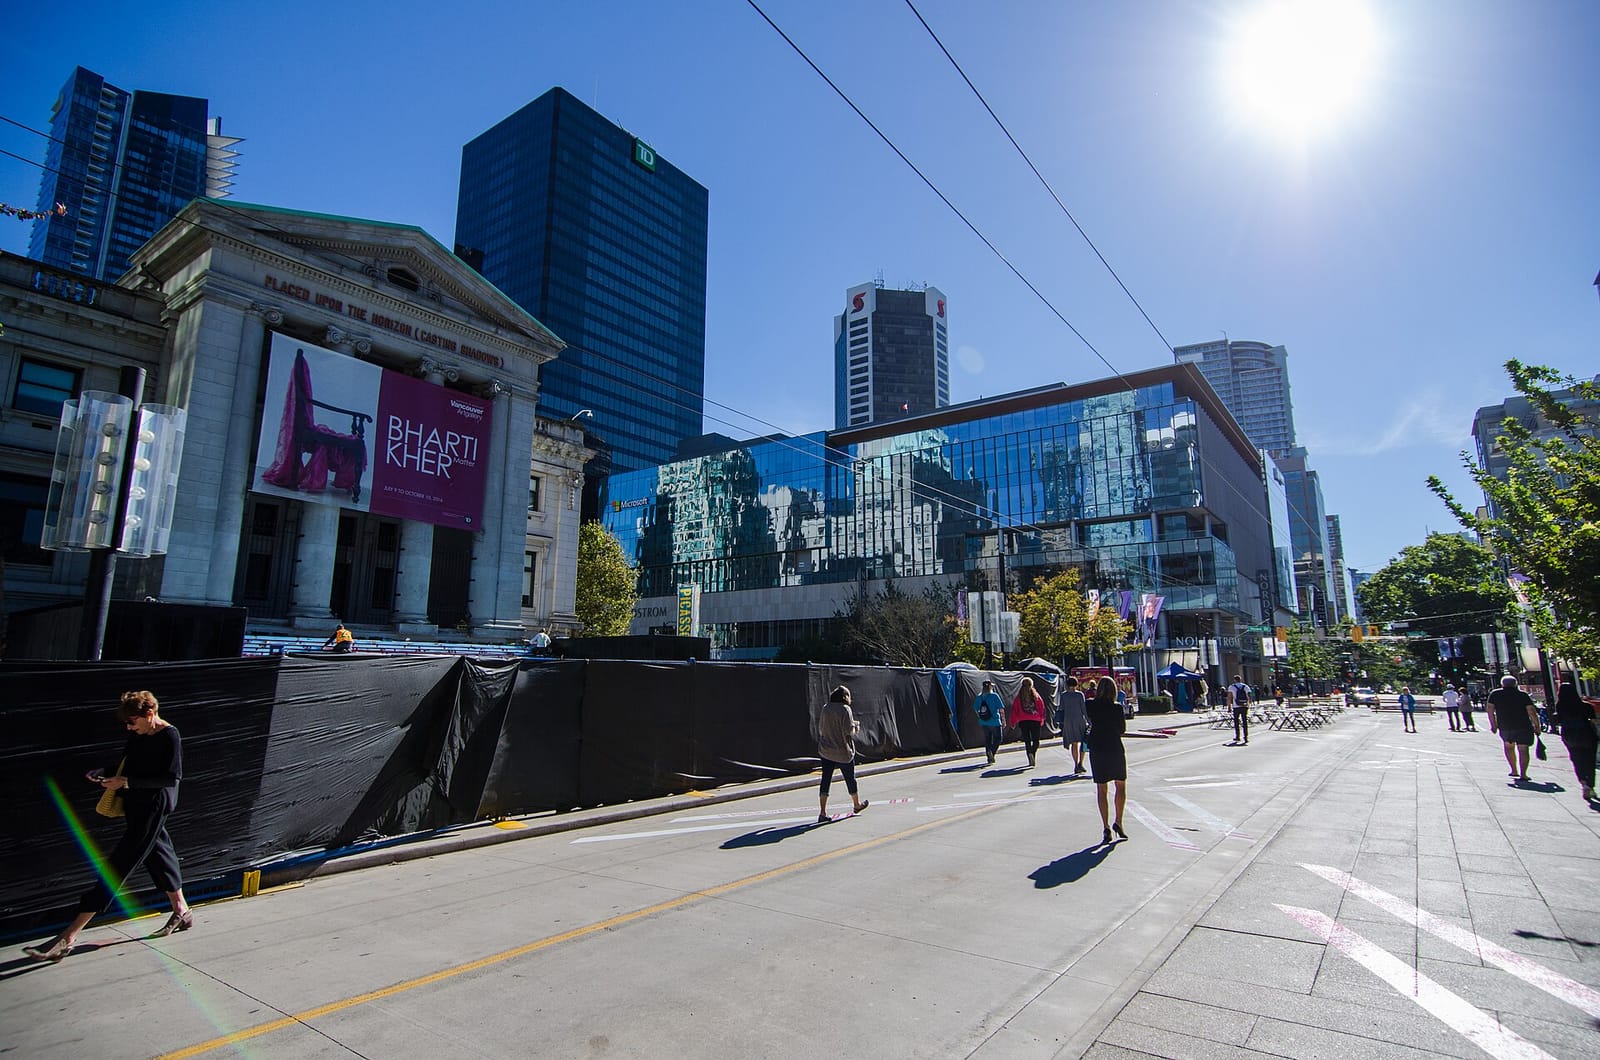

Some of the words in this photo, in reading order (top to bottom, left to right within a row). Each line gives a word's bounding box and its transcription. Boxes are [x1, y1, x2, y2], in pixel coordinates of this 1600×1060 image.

[638, 143, 654, 166] TD
[264, 275, 310, 300] PLACED
[315, 293, 343, 312] UPON
[348, 304, 368, 321] THE
[371, 312, 412, 337] HORIZON
[450, 399, 484, 415] Vancouver
[388, 415, 478, 461] BHARTI
[386, 439, 453, 479] KHER
[453, 456, 475, 467] Matter
[620, 497, 648, 508] Microsoft
[1175, 635, 1241, 648] NOTROM
